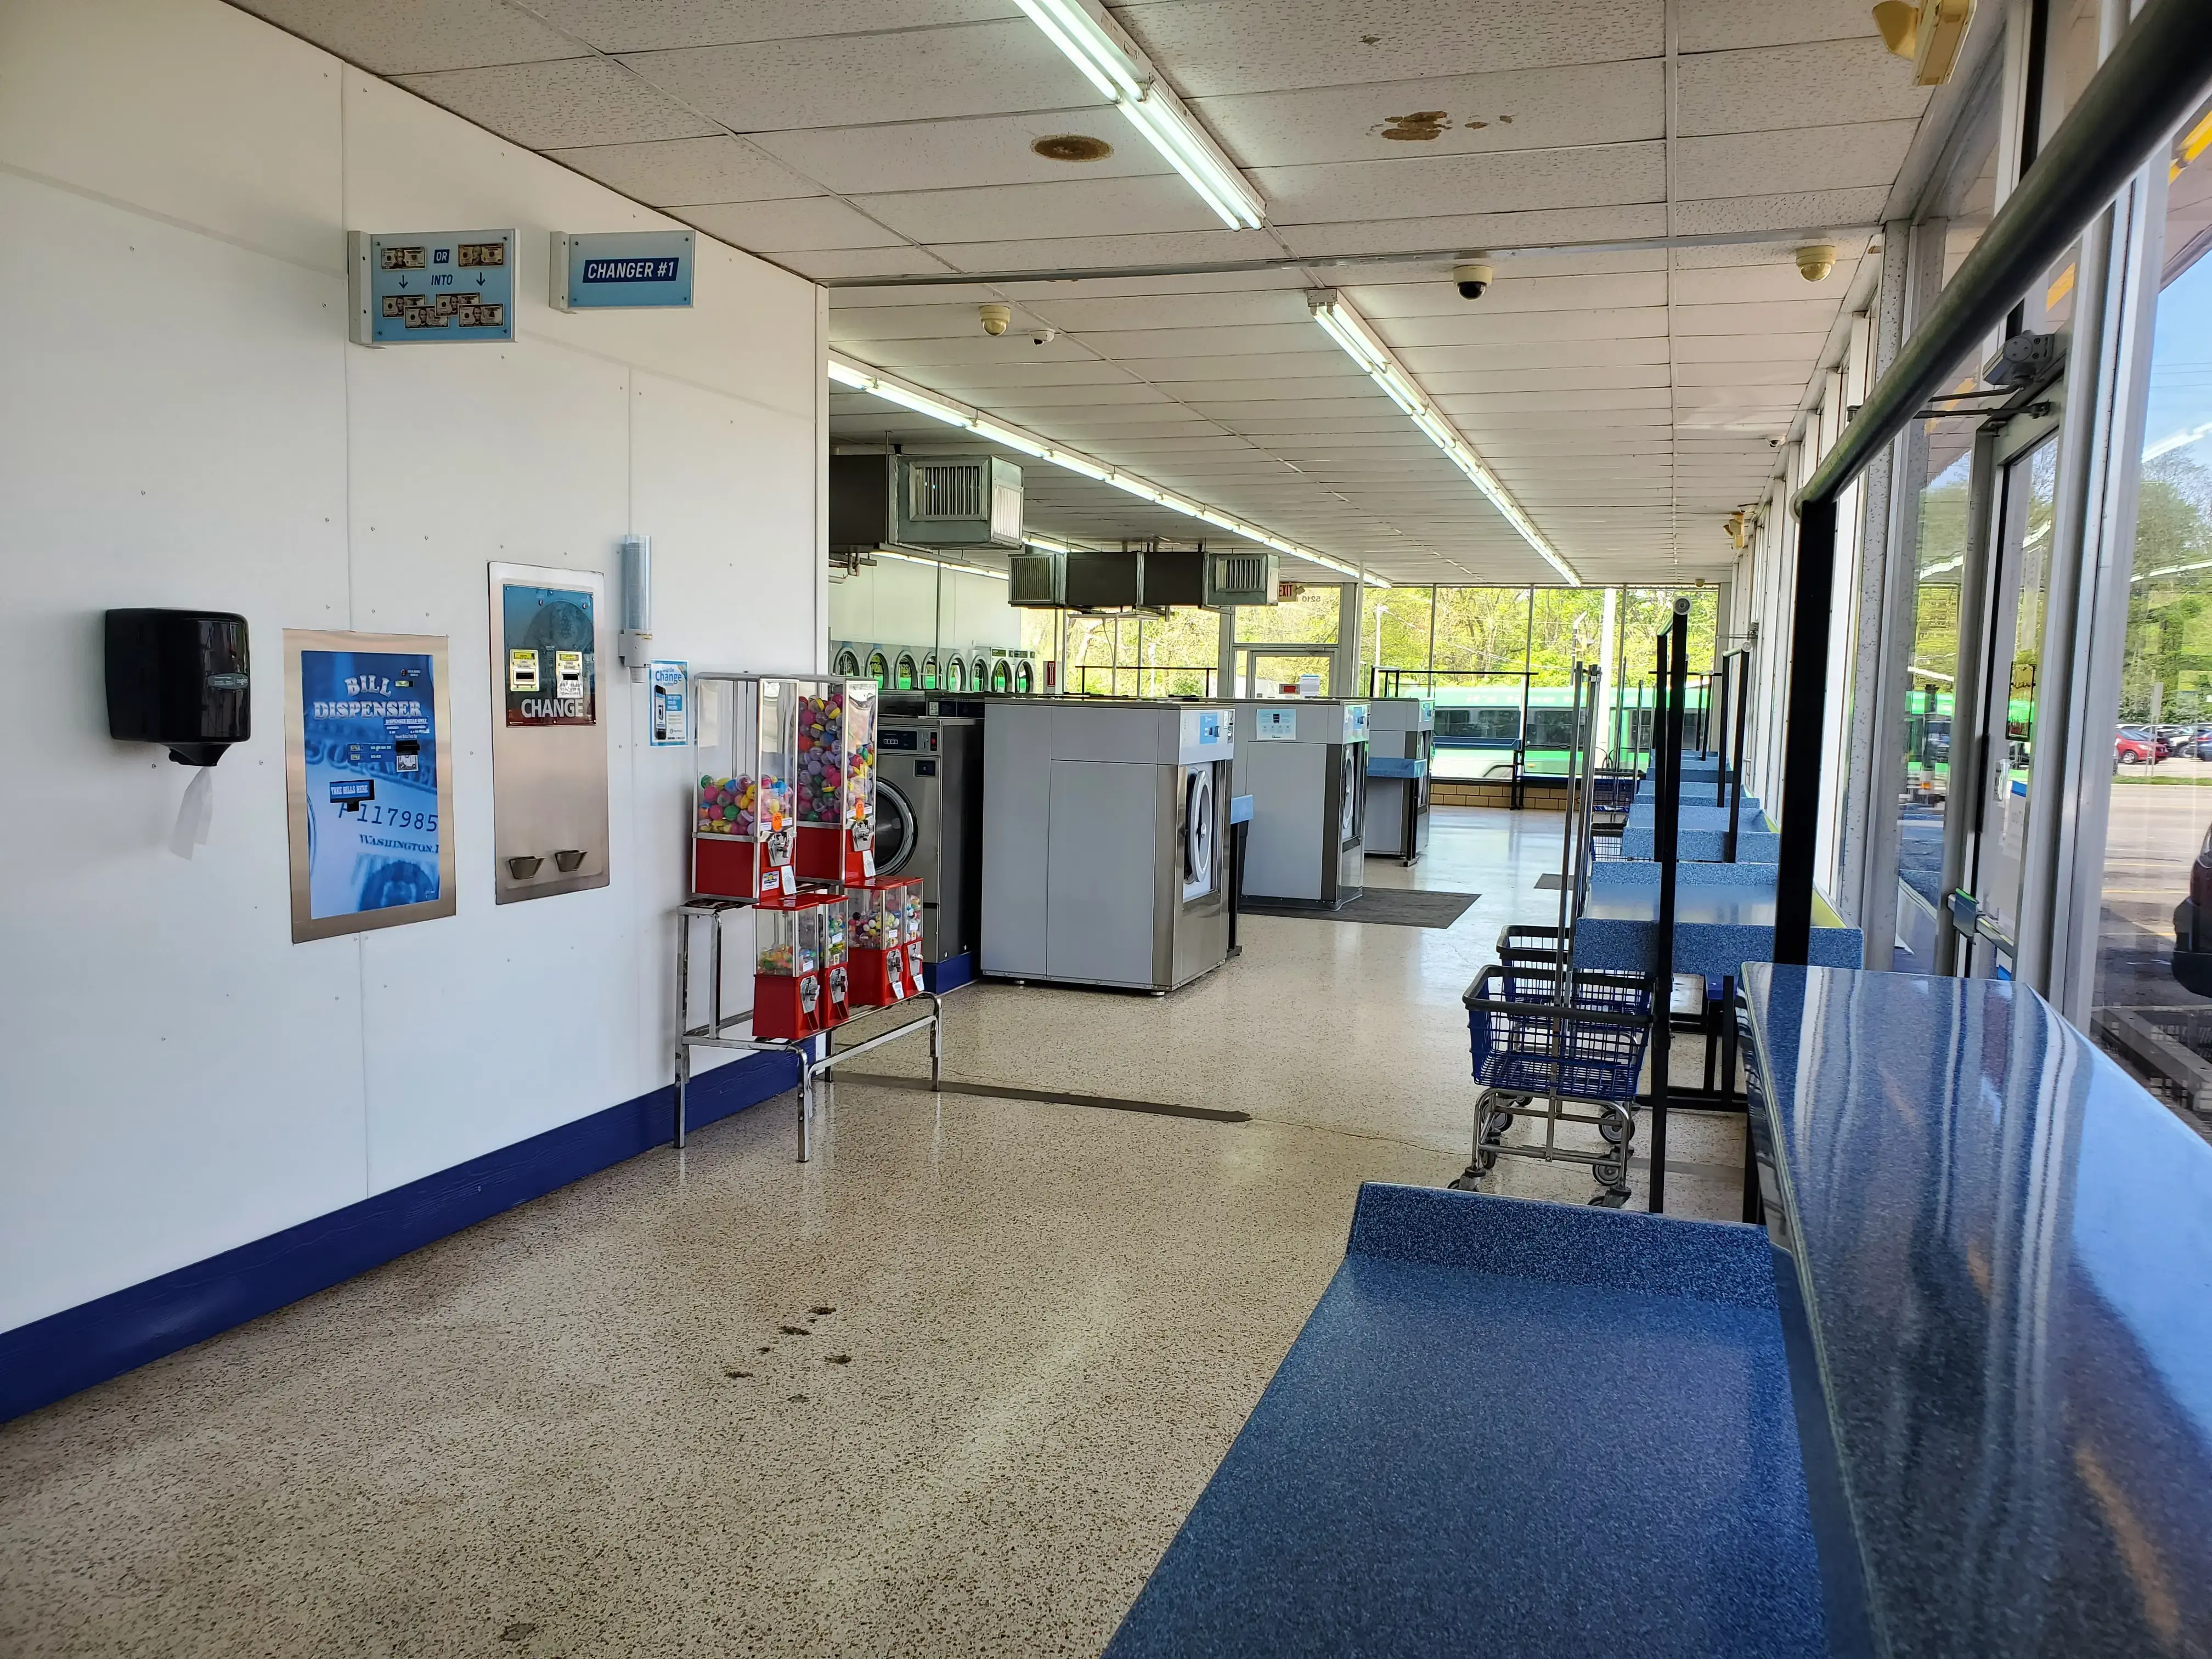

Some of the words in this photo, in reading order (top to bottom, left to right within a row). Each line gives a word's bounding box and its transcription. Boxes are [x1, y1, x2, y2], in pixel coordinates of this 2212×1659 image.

[436, 251, 448, 262] OR
[588, 262, 654, 279] CHANGER
[657, 261, 674, 277] #1
[431, 274, 453, 286] INTO
[1278, 584, 1293, 597] EXIT
[655, 670, 682, 685] Change
[344, 674, 392, 698] BILL
[313, 701, 422, 720] DISPENSER
[521, 698, 584, 718] CHANGE
[331, 786, 343, 795] TAKE
[343, 785, 356, 794] BILLS
[356, 785, 368, 793] HERE
